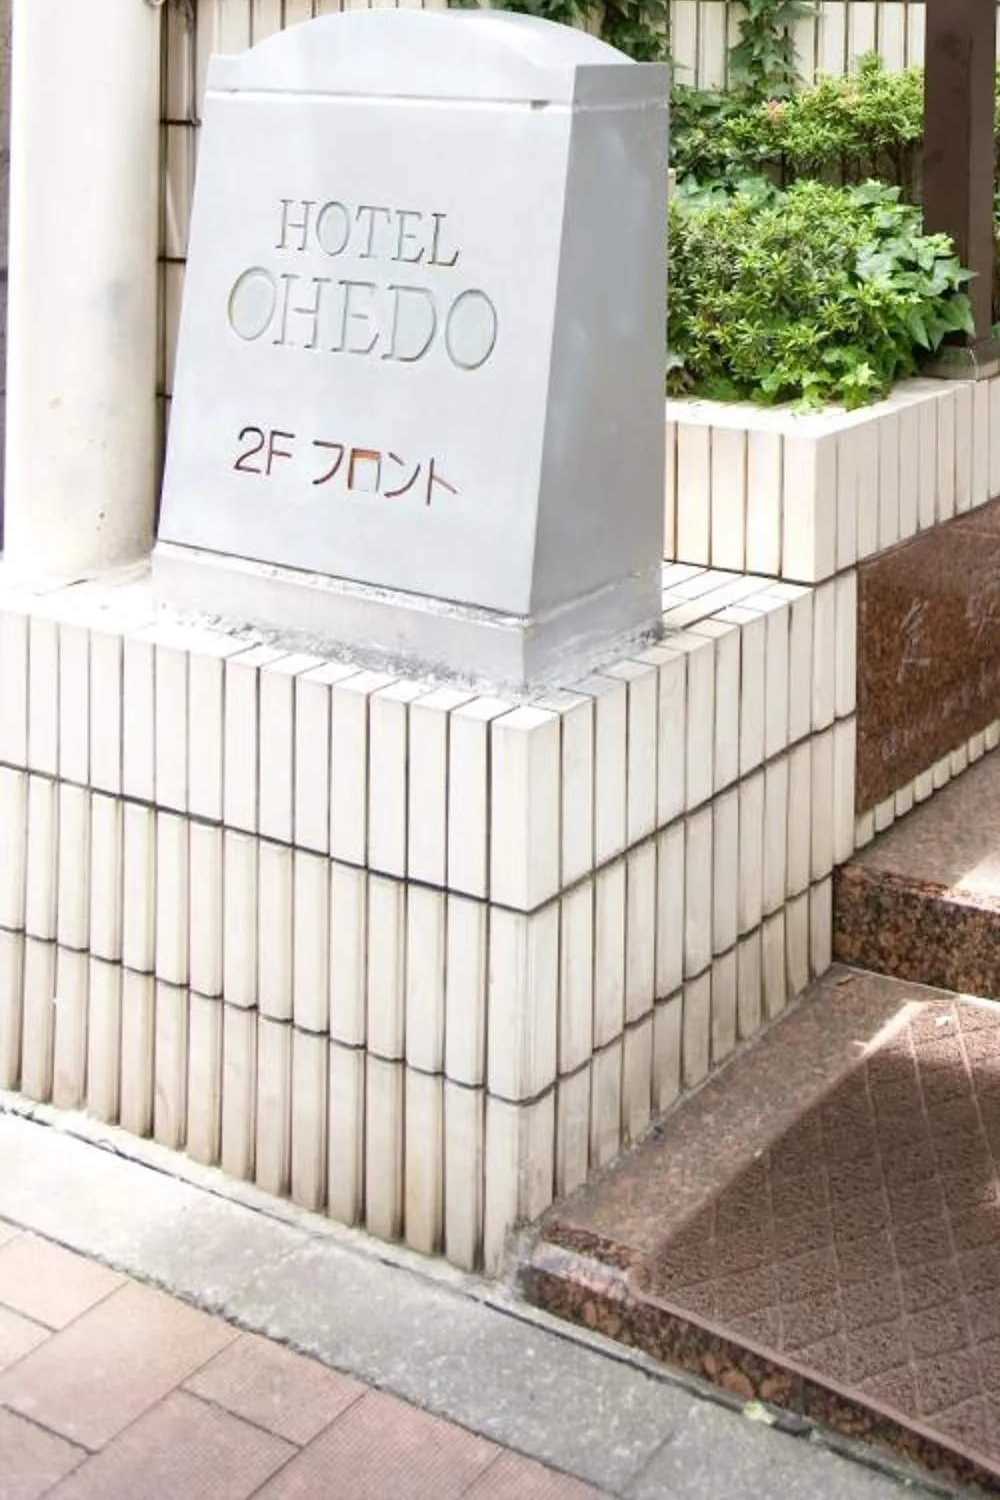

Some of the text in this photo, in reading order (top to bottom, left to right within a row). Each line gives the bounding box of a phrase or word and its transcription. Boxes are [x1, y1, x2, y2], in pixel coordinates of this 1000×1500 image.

[275, 199, 460, 267] HOTEL
[227, 266, 498, 371] OHEDO
[233, 426, 460, 505] 2F フロント
